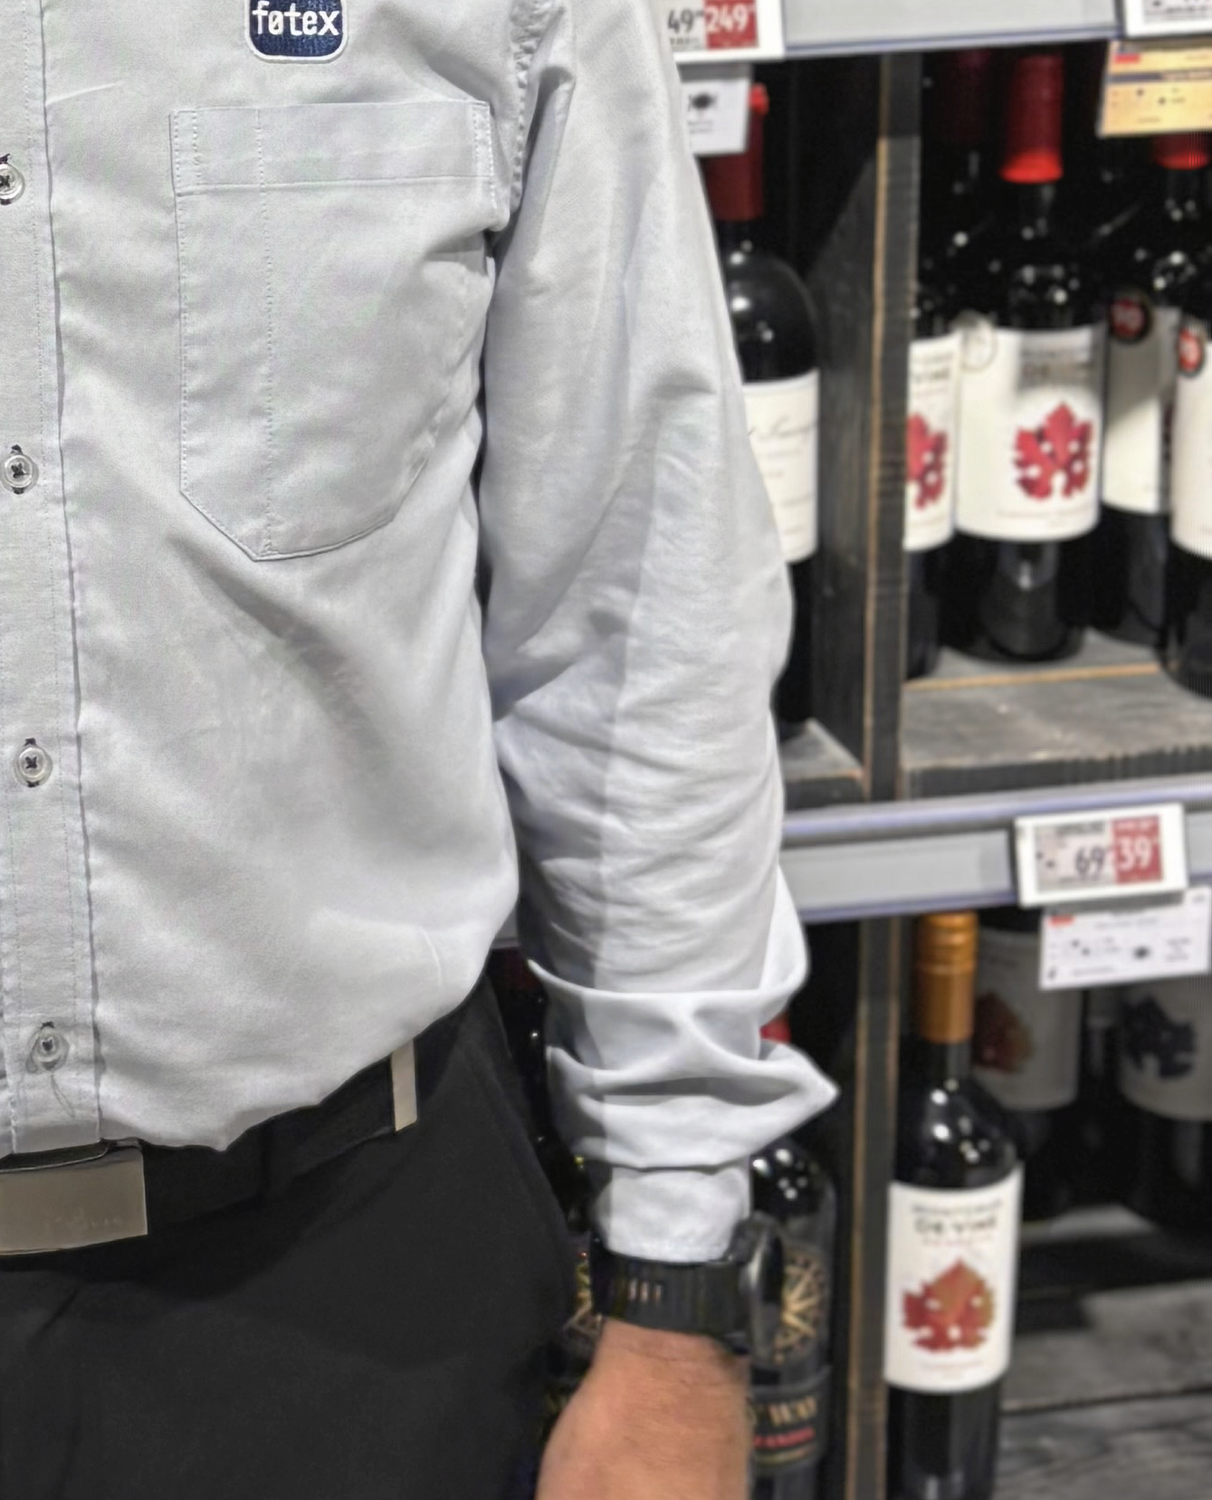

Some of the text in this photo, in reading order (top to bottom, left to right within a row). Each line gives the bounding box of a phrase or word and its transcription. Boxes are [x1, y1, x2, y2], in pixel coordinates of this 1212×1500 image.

[251, 0, 341, 36] føtex
[705, 3, 749, 33] 249
[1075, 836, 1153, 877] 69 39
